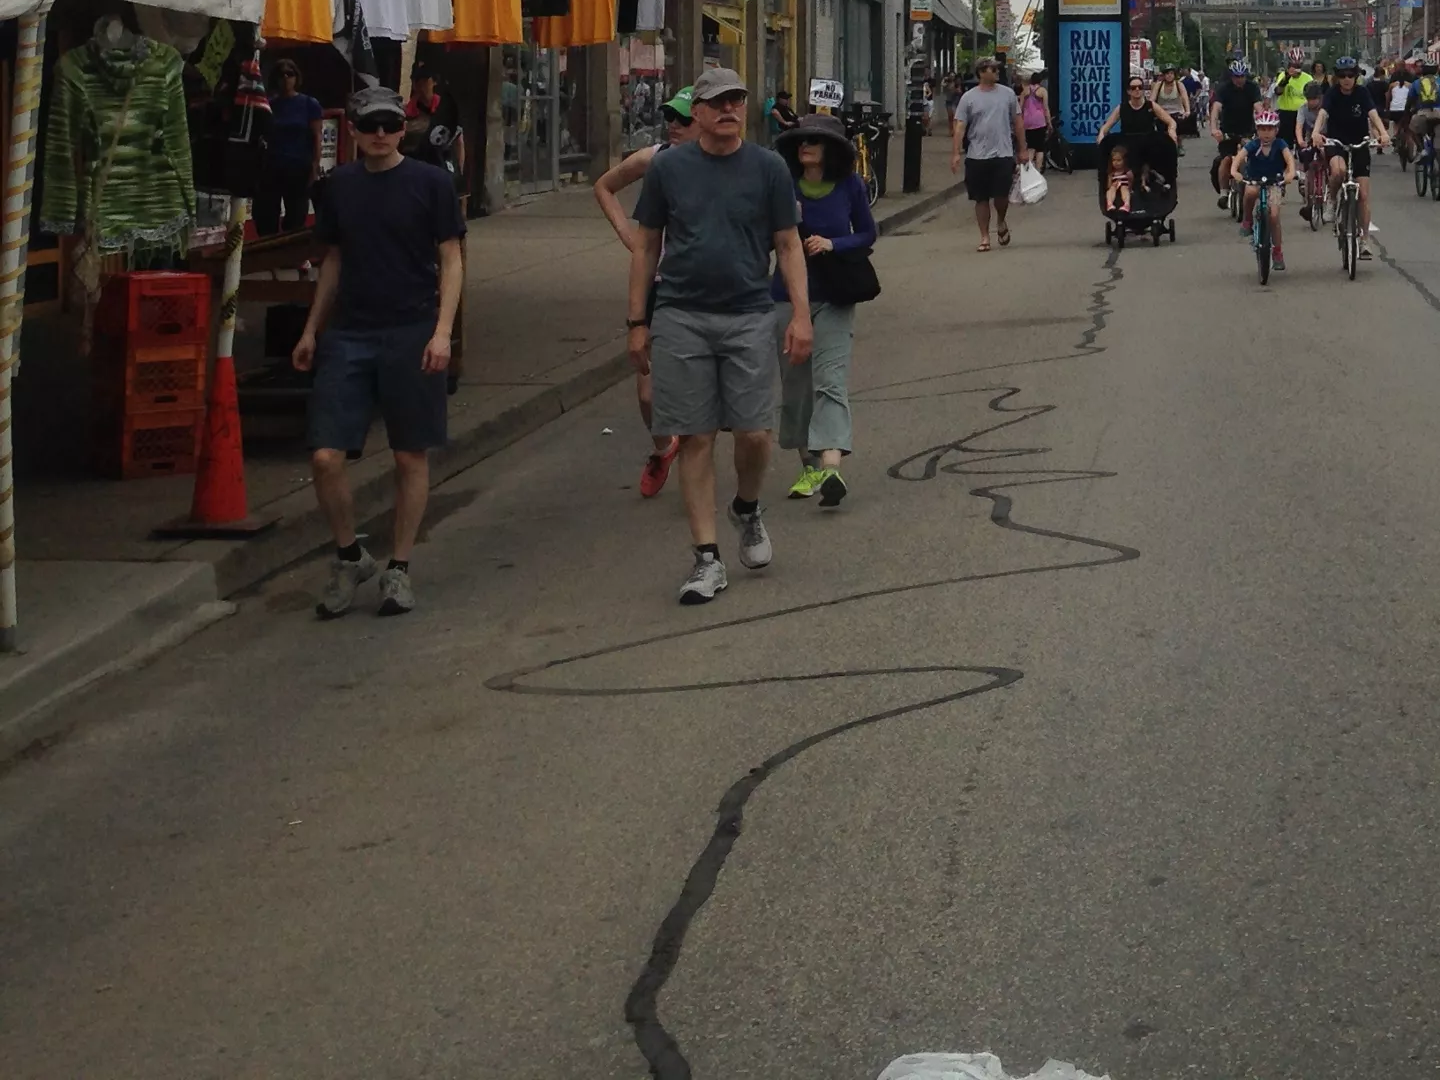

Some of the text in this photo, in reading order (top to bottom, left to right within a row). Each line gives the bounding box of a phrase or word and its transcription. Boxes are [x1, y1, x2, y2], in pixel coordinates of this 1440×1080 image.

[1070, 30, 1111, 50] RUN
[1071, 51, 1110, 66] WALK
[1071, 67, 1111, 82] SKATE
[826, 83, 836, 92] NO
[1071, 83, 1111, 103] BIKE
[1071, 103, 1111, 121] SHOP
[1071, 121, 1105, 137] SALS
